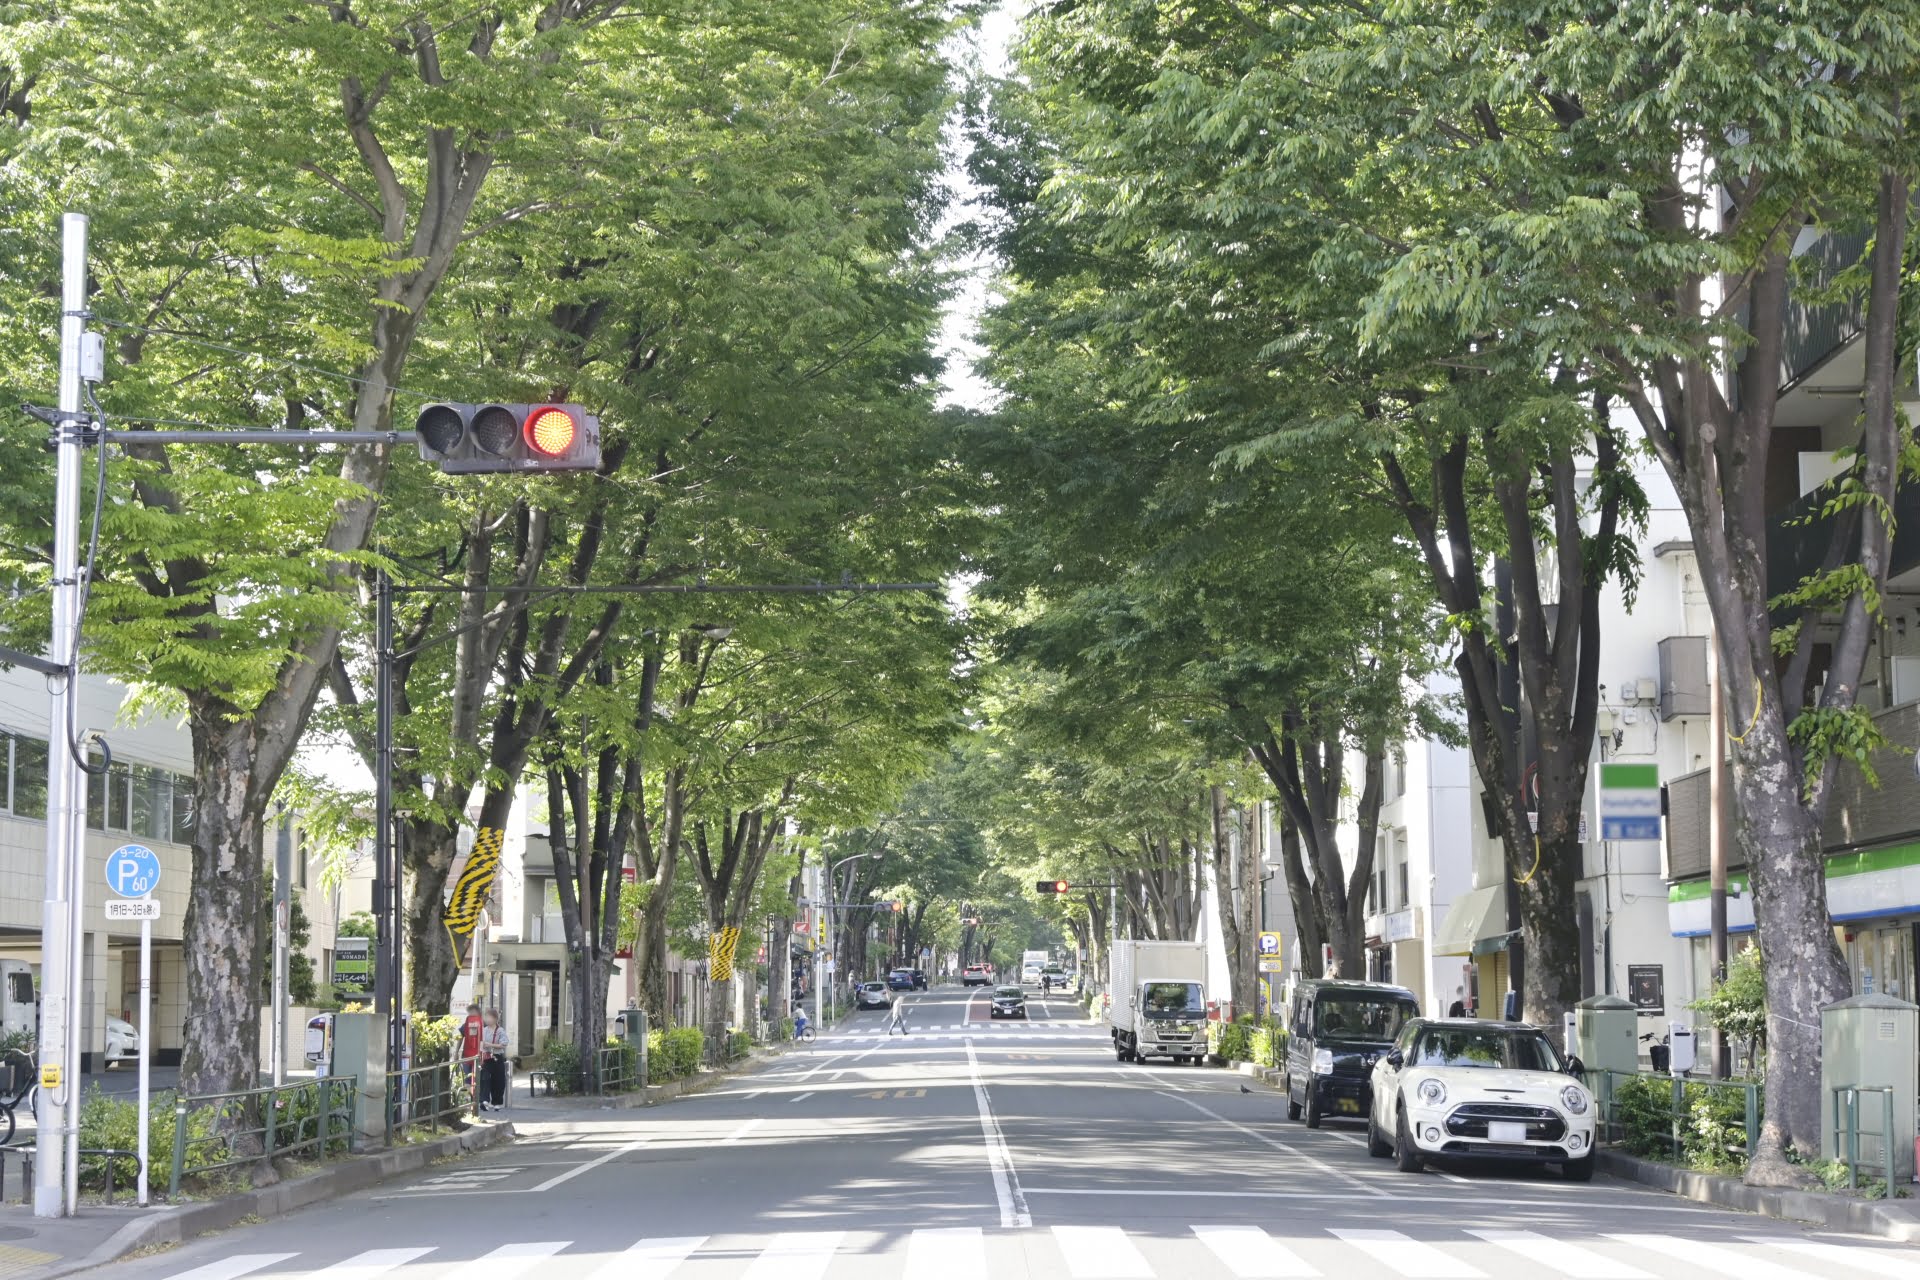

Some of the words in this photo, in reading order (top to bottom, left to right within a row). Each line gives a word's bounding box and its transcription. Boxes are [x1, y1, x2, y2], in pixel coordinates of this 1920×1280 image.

[120, 848, 149, 859] 9-20
[118, 859, 139, 892] P
[132, 877, 148, 892] 60
[852, 1088, 927, 1100] 40
